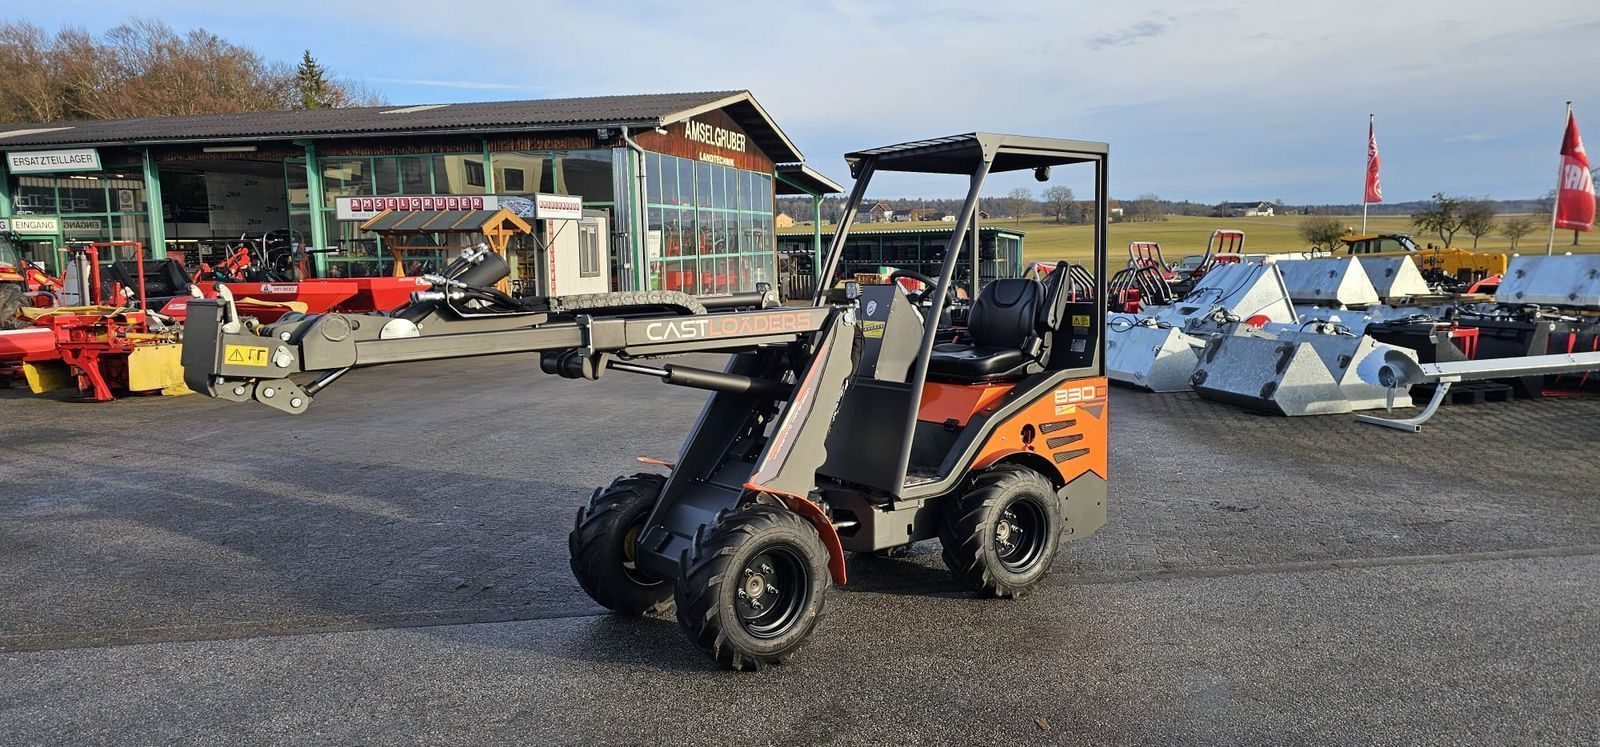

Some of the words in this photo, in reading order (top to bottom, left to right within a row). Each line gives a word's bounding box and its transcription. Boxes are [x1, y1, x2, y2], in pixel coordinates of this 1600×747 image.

[685, 120, 746, 153] AMSELGRUBER
[13, 154, 93, 167] ERSATZTEILLAGER
[351, 197, 482, 209] AMSELGRUBER
[15, 220, 54, 229] EINGANG
